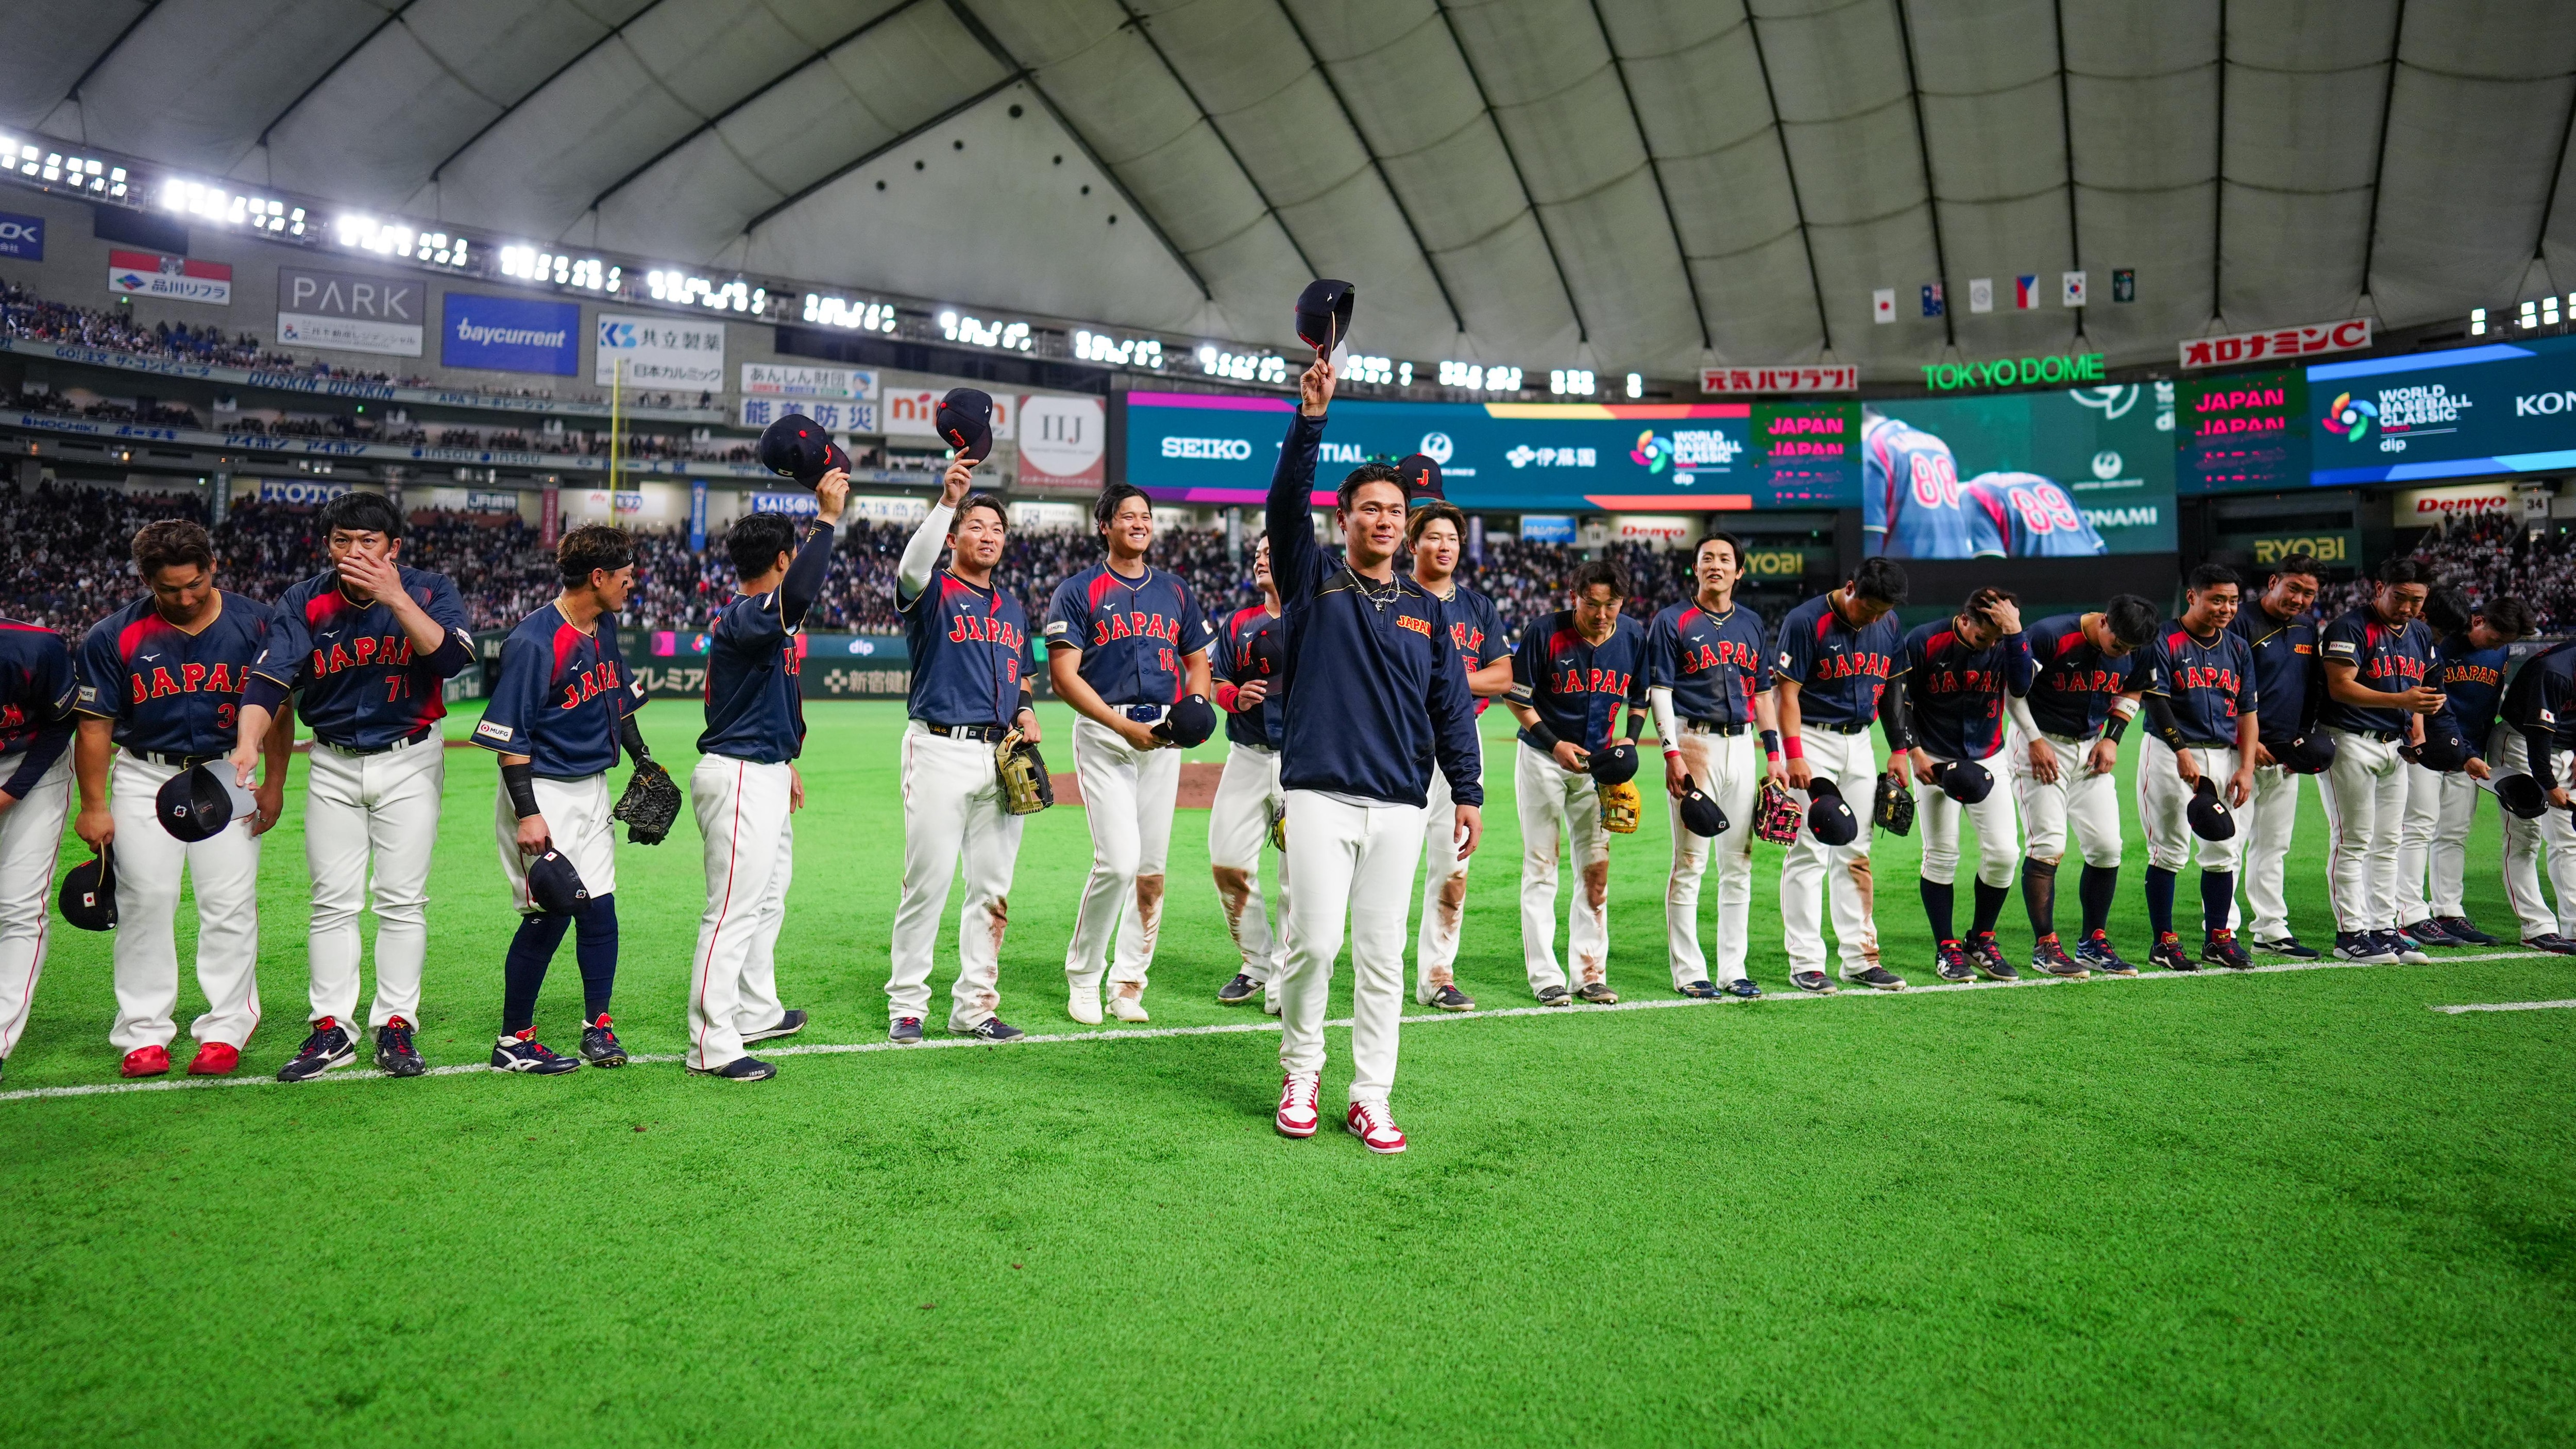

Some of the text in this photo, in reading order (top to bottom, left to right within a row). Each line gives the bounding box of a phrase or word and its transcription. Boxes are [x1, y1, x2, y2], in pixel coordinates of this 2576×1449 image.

[151, 279, 226, 299] 品川リフラ
[293, 277, 409, 319] PARK
[456, 317, 565, 348] baycurrent
[2186, 321, 2366, 365] オロナミンC
[634, 363, 720, 382] 日本カルミック
[1922, 353, 2106, 390] TOKYO DOME
[2195, 388, 2284, 413] JAPAN
[2379, 384, 2445, 403] WORLD
[2379, 394, 2472, 415] BASEBALL
[1768, 417, 1843, 435] JAPAN
[2379, 407, 2458, 427] CLASSIC
[1673, 431, 1723, 442] WORLD
[2380, 438, 2406, 453] dip
[1162, 437, 1251, 460] SEIKO
[1536, 447, 1596, 467] 伊藤園
[1673, 441, 1742, 453] BASEBALL
[1673, 452, 1732, 463] CLASSIC
[1416, 469, 1430, 487] J
[1673, 473, 1694, 486] dip
[264, 484, 346, 503] TOTO
[757, 497, 819, 512] SAISON
[2009, 483, 2080, 534] 89
[2417, 495, 2507, 514] Denyo
[2527, 498, 2544, 510] 34
[1621, 524, 1685, 540] Denyo
[2255, 536, 2345, 564] RYOBI
[1745, 552, 1802, 574] YOBI
[948, 615, 1024, 659] JAPAN
[1093, 612, 1180, 646] JAPAN
[1396, 615, 1431, 639] JAPAN
[849, 640, 874, 656] dip
[1684, 641, 1758, 674] JAPAN
[1158, 648, 1175, 671] 16
[1817, 652, 1891, 680] JAPAN
[2367, 654, 2426, 683] JAPAN
[1551, 669, 1631, 696] JAPAN
[2172, 667, 2241, 697] JAPAN
[2444, 665, 2498, 687] JAPAN
[1987, 700, 1997, 719] 3
[490, 728, 509, 738] MUFG
